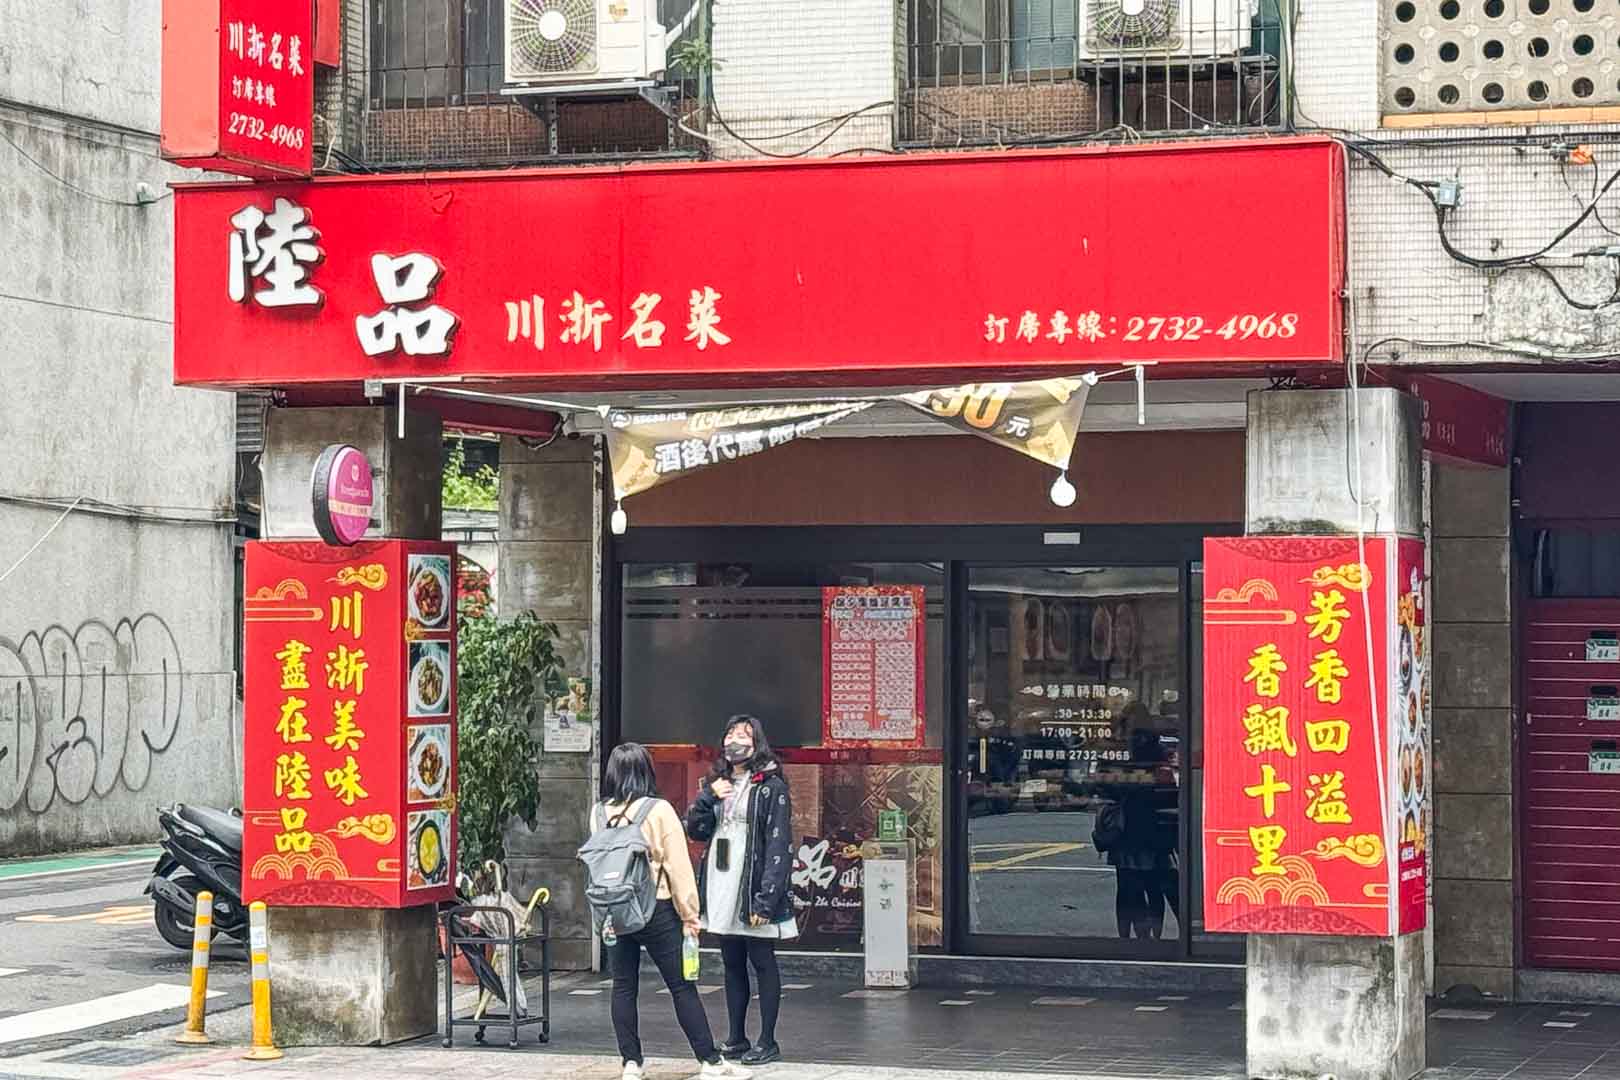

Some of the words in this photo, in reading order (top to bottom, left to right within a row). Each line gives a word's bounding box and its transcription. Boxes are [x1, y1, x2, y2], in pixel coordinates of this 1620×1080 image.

[228, 112, 304, 150] 2732-4968
[504, 285, 732, 352] 川浙名菜
[274, 639, 315, 854] 盡在陸品
[324, 590, 369, 806] 川浙美味
[1243, 643, 1298, 876] 香飄十里
[1303, 589, 1352, 825] 芳香四溢
